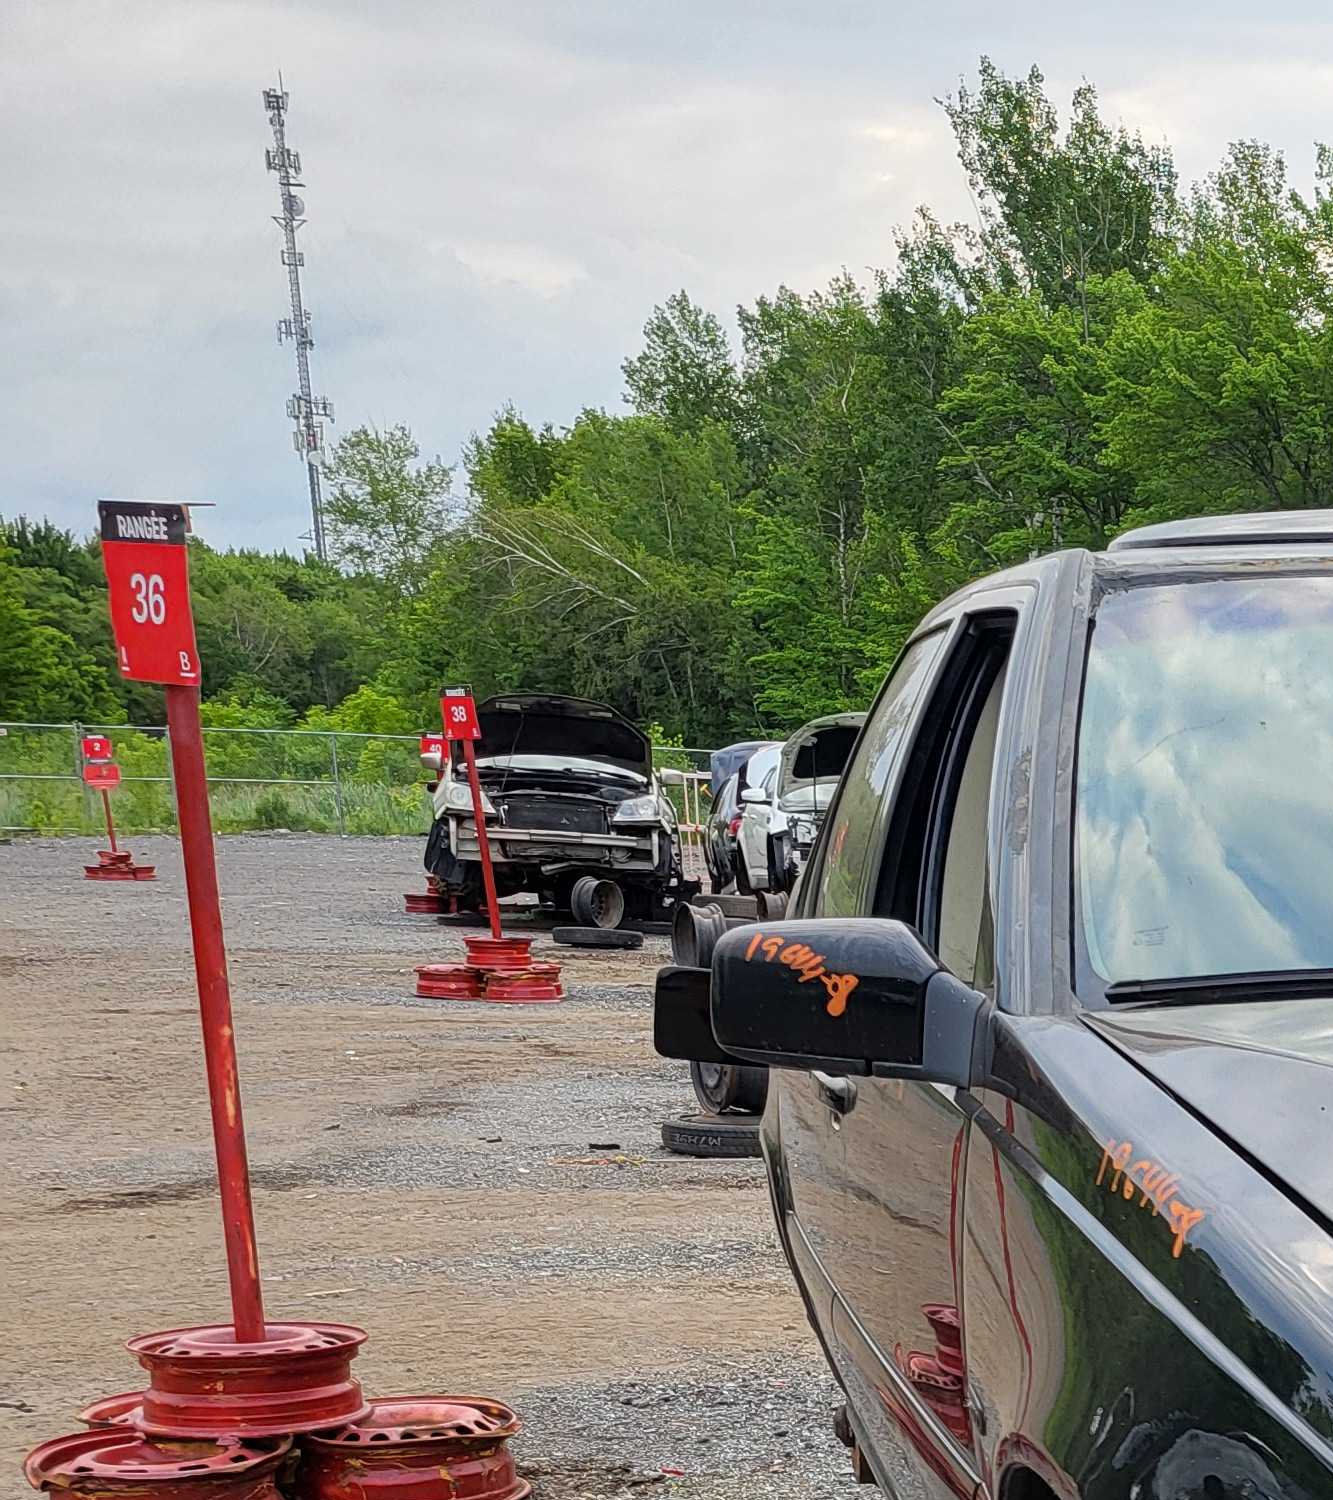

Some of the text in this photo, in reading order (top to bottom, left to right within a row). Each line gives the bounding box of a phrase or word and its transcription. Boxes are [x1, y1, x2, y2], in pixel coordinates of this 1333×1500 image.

[116, 510, 169, 540] RANGÉE
[130, 573, 166, 625] 36
[179, 651, 191, 671] B
[451, 706, 467, 722] 38
[93, 742, 101, 751] 2
